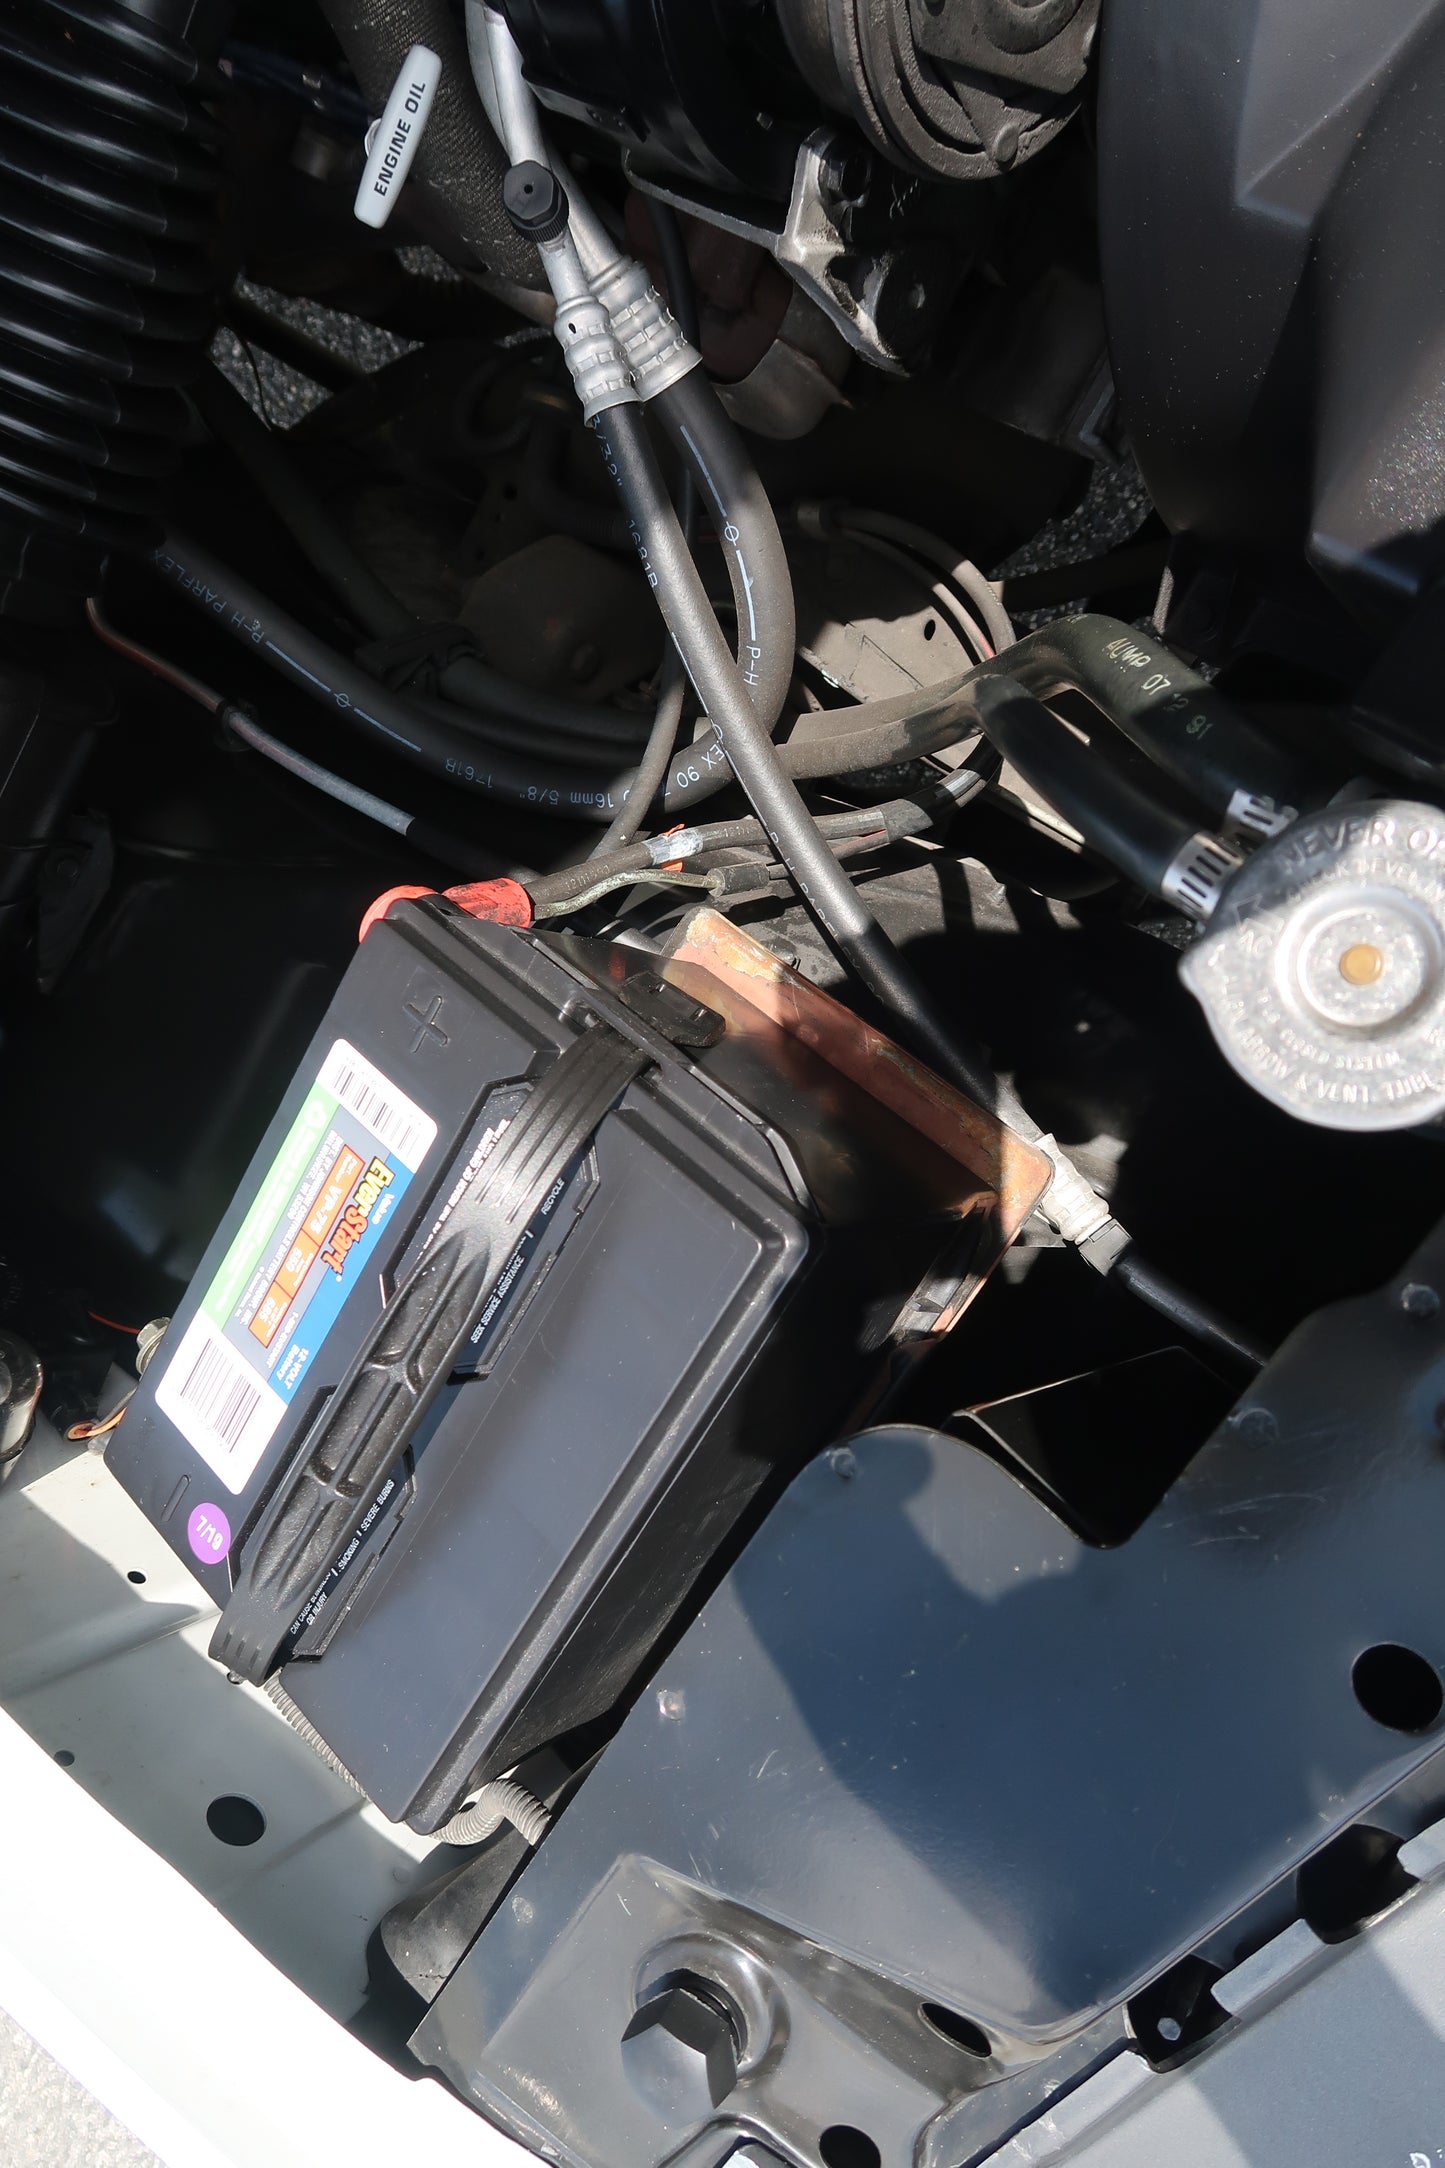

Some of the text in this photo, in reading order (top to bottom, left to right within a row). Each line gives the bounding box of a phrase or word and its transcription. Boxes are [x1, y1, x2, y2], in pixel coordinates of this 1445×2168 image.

[373, 79, 426, 198] ENGINE OIL
[149, 549, 227, 614] PARFLEX
[743, 645, 760, 685] P-H
[1140, 673, 1170, 696] 07
[569, 791, 613, 807] 16mm
[1277, 816, 1396, 876] NEVER
[302, 1167, 325, 1207] JOHNSON
[447, 1177, 468, 1207] REACH
[461, 1165, 474, 1180] OF
[469, 1127, 494, 1168] CHILDREN
[309, 1184, 342, 1234] VP-75
[320, 1155, 394, 1274] EverStart
[370, 1194, 394, 1225] Value
[541, 1177, 564, 1215] RECYCLE
[282, 1204, 307, 1246] CONTROLS
[264, 1244, 286, 1280] BATTERY
[469, 1322, 485, 1343] SEEK
[480, 1295, 500, 1326] SERVICE
[275, 1343, 300, 1381] Battery
[281, 1348, 310, 1389] 12-VOLT
[360, 1478, 395, 1531] SEVERE BURNS
[337, 1537, 359, 1569] SMOKING
[311, 1591, 327, 1615] INJURY
[290, 1620, 300, 1634] CAN
